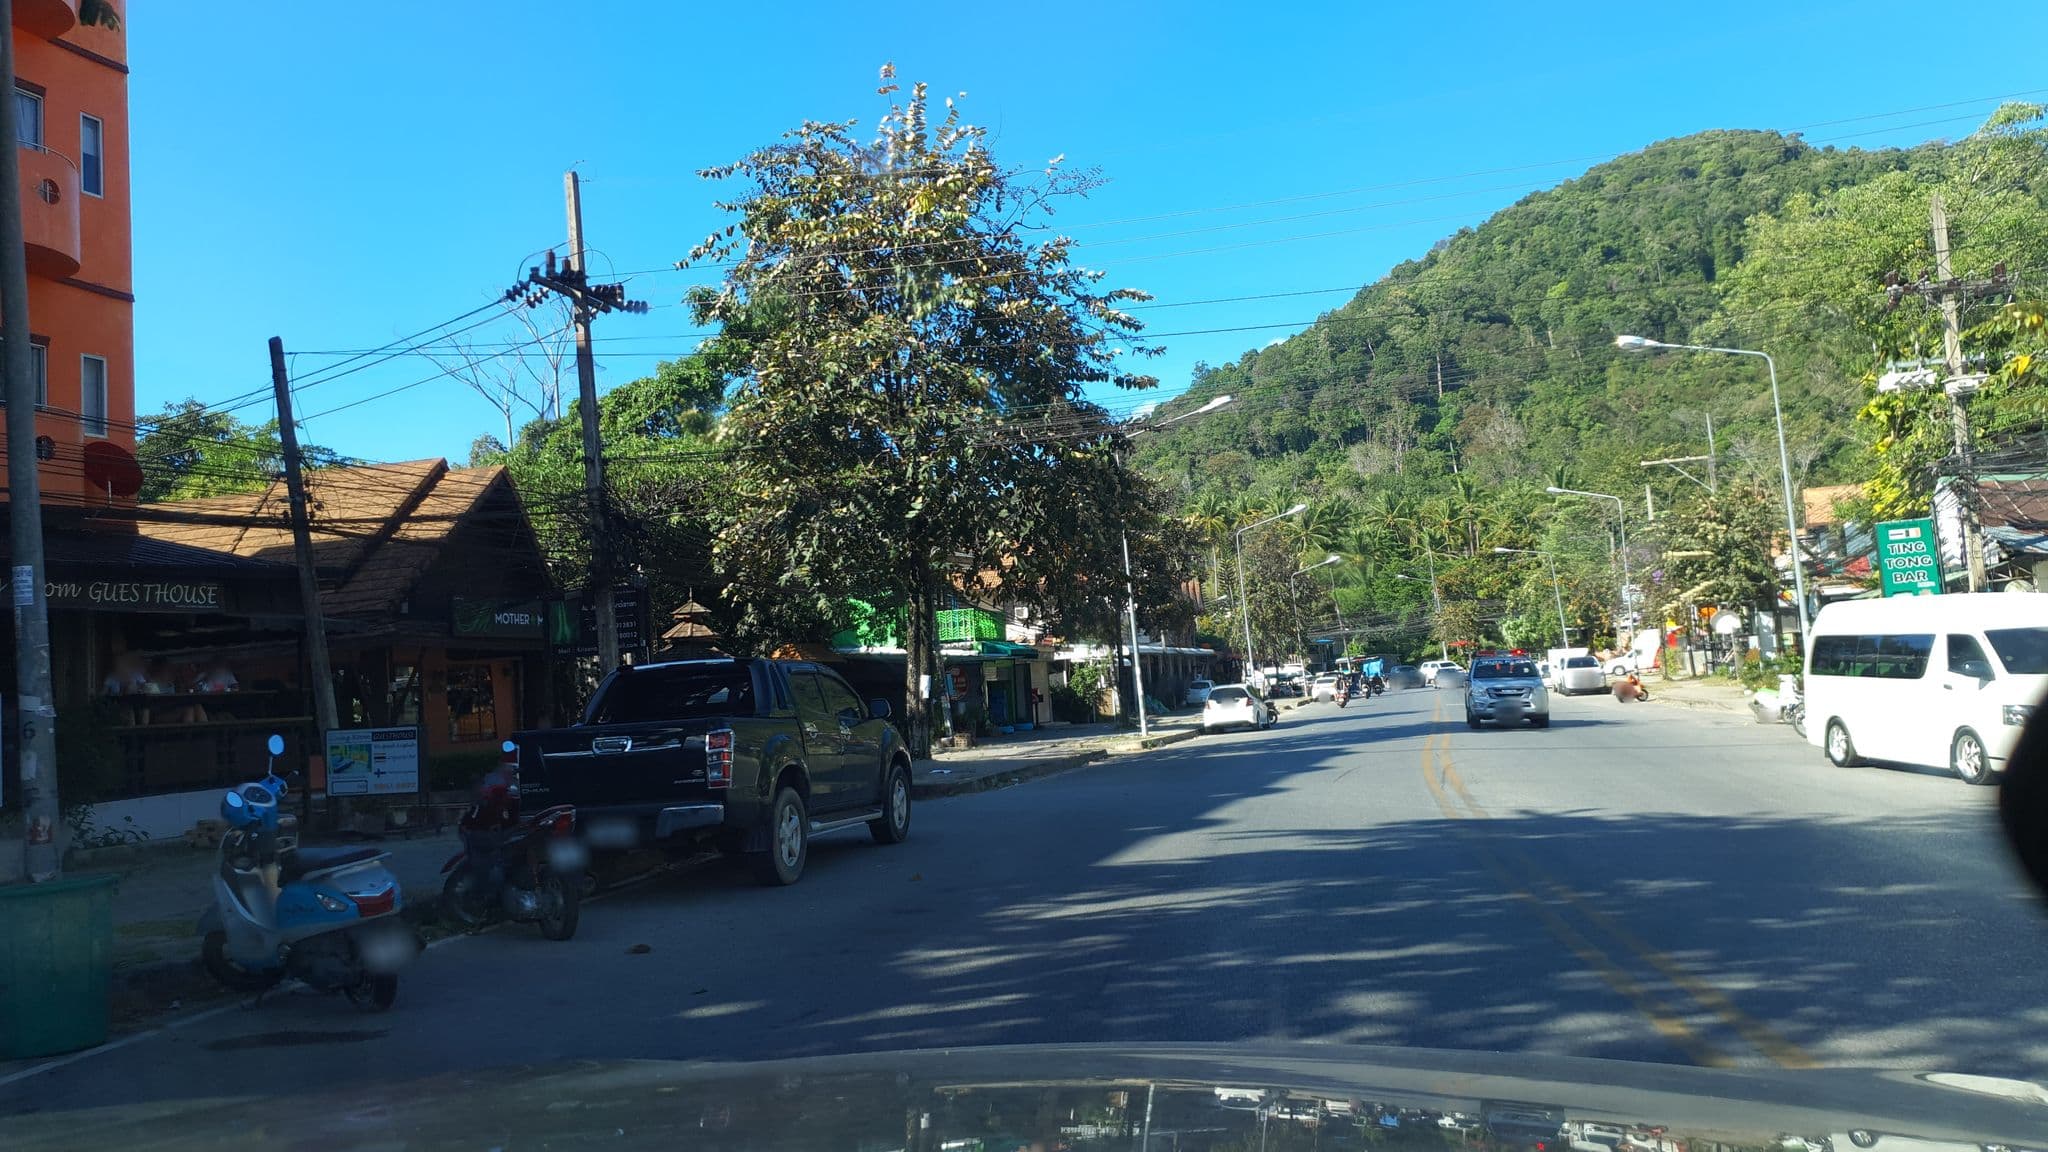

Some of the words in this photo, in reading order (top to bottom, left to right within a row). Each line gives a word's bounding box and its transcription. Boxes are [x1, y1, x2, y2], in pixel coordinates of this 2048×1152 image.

[1887, 541, 1926, 555] TING
[1885, 555, 1933, 569] TONG
[1893, 571, 1928, 584] BAR
[45, 582, 82, 598] om
[89, 582, 218, 604] GUESTHOUSE
[495, 612, 530, 625] MOTHER
